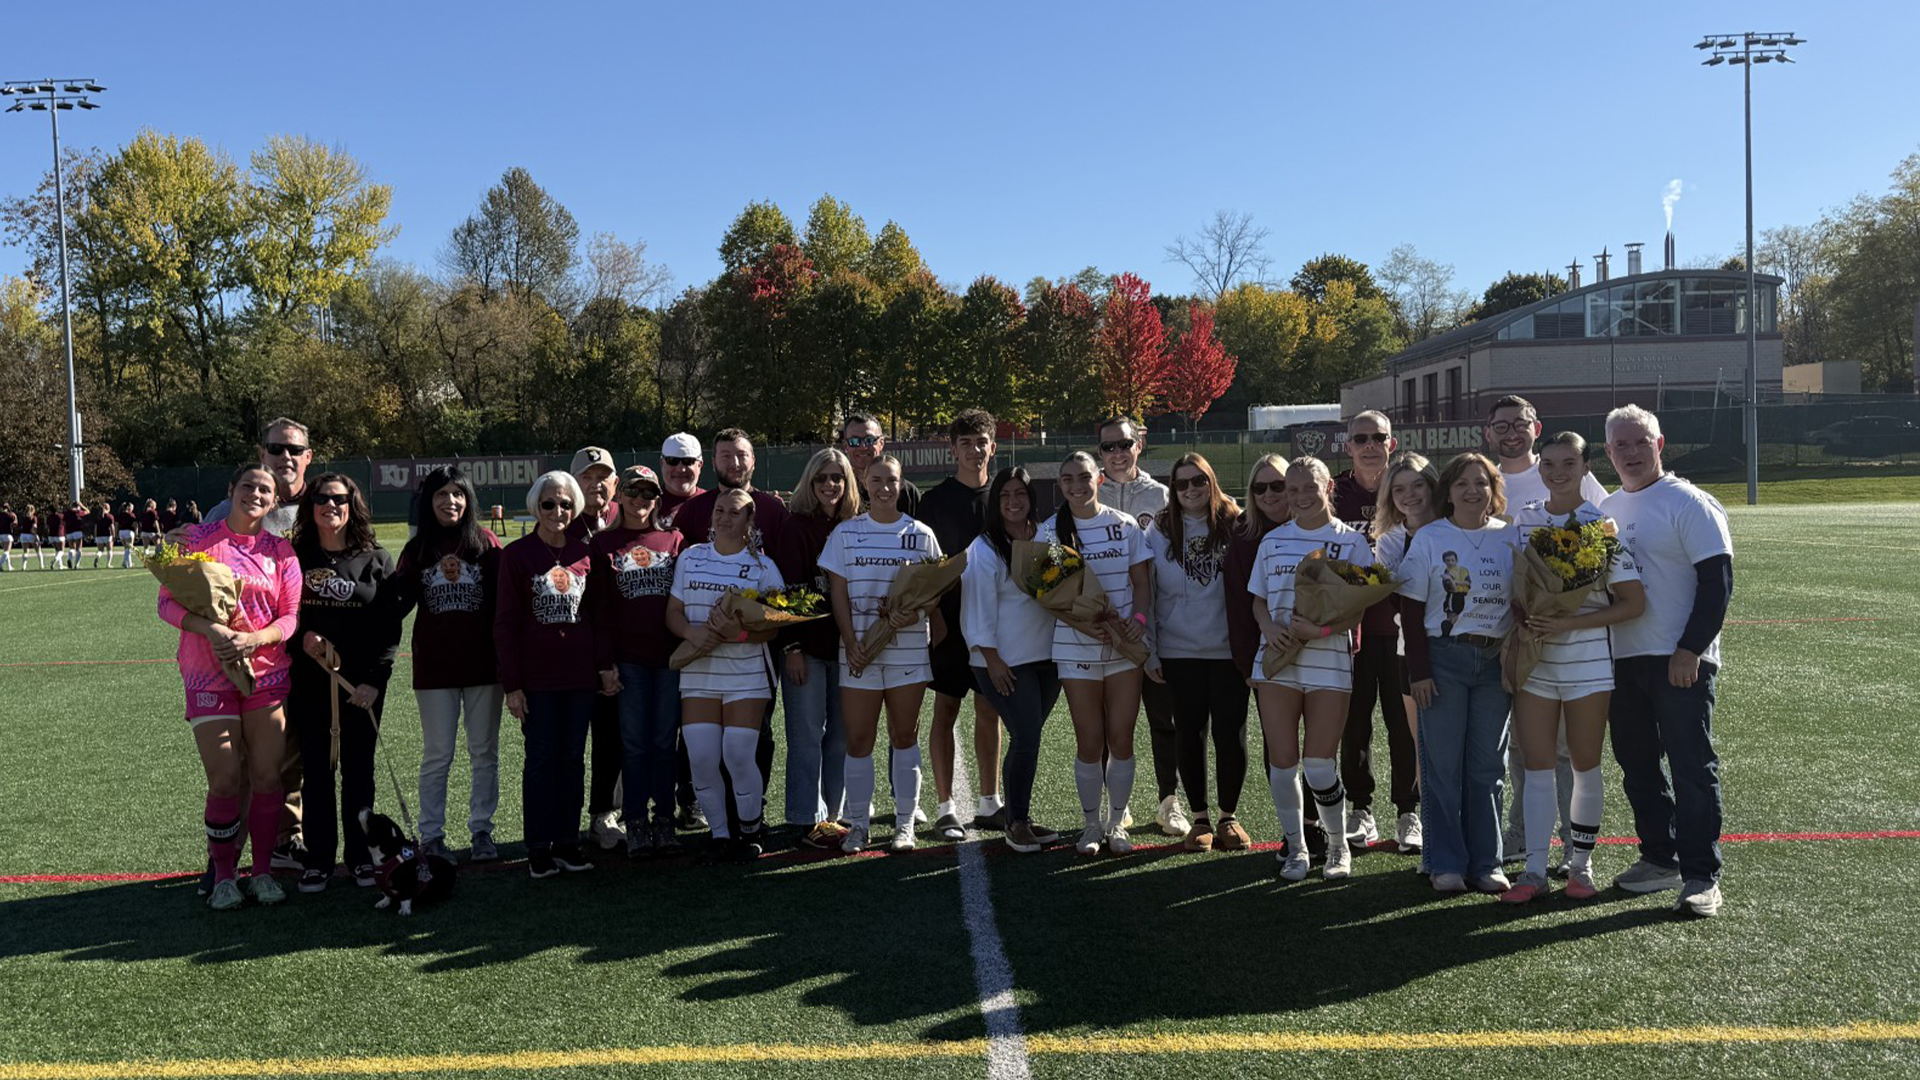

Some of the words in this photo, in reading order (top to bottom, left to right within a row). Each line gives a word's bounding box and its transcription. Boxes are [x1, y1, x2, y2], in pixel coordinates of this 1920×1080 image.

[1334, 432, 1349, 442] HOM
[1392, 429, 1422, 451] DEN
[1425, 426, 1482, 449] BEARS
[380, 465, 409, 487] KU
[457, 460, 538, 485] GOLDEN
[1105, 525, 1122, 541] 16
[901, 534, 917, 550] 10
[739, 564, 750, 579] 2
[1479, 569, 1502, 577] LOVE
[319, 578, 355, 601] KU
[629, 577, 665, 591] FANS
[1481, 583, 1502, 591] OUR
[436, 593, 472, 606] FANS
[197, 692, 217, 707] KU
